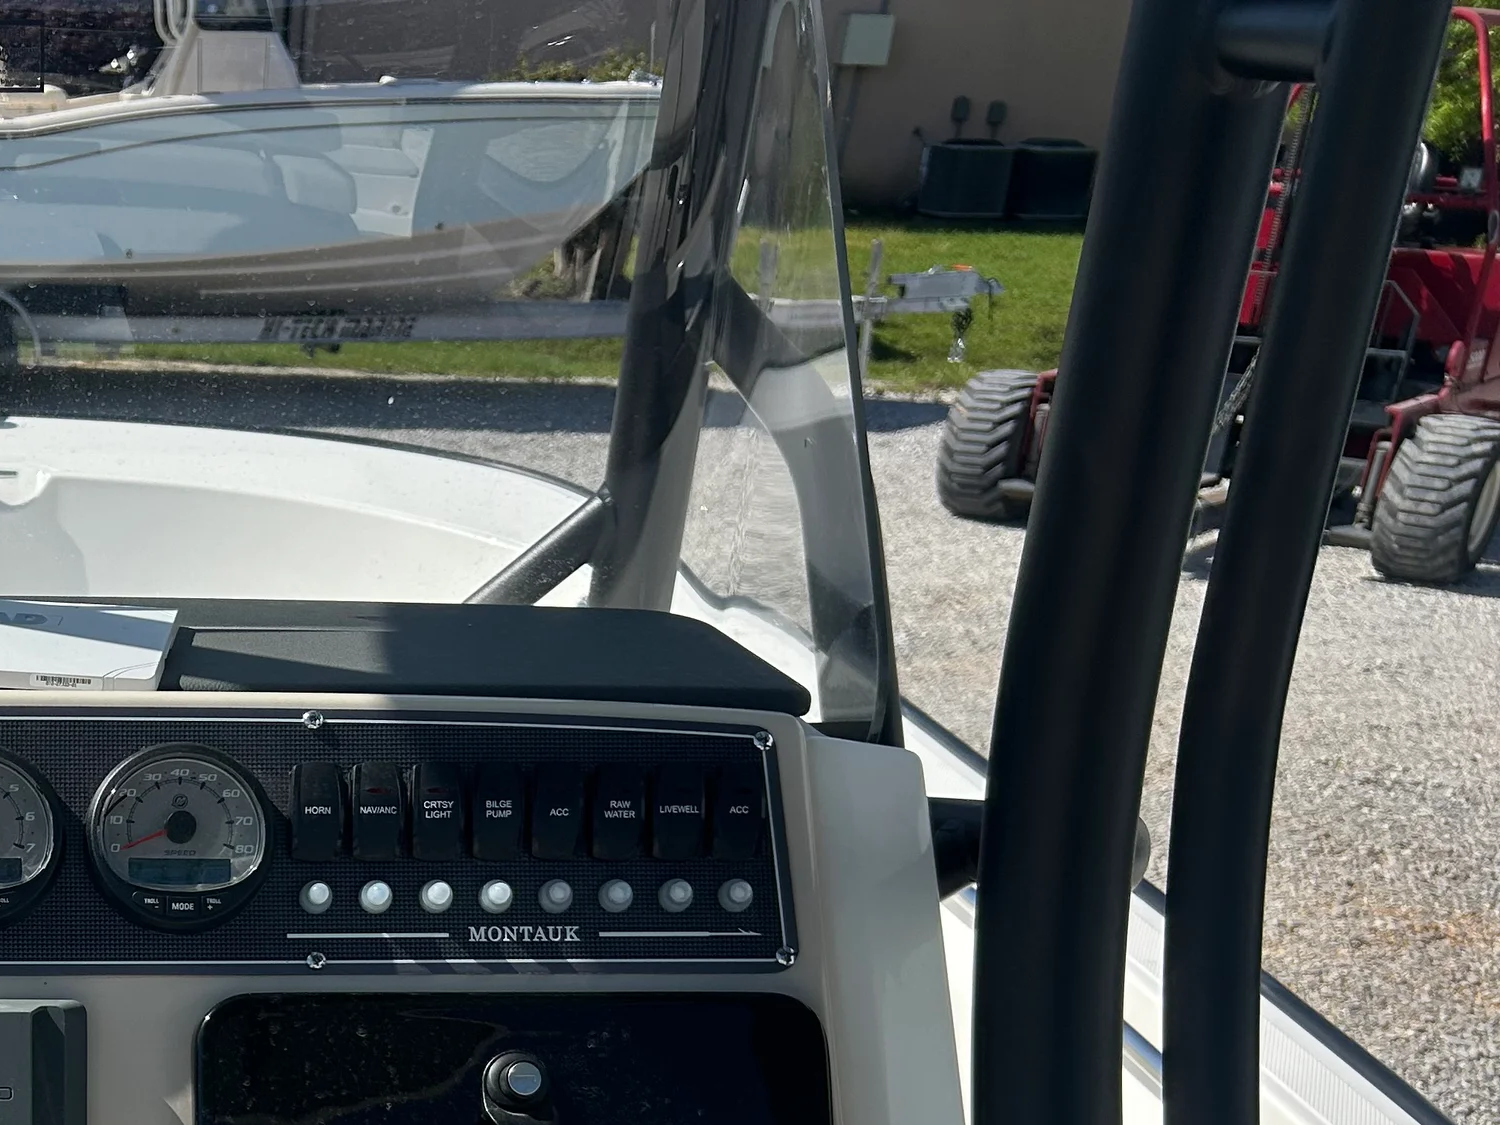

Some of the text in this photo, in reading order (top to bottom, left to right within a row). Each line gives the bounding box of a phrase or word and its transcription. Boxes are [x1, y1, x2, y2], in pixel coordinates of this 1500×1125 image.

[199, 774, 217, 782] 50
[9, 784, 19, 792] 5
[119, 788, 137, 797] 20
[222, 789, 240, 797] 60
[423, 800, 454, 809] CRTSY
[485, 800, 512, 809] BILGE
[610, 800, 631, 809] RAW
[305, 806, 332, 815] HORN
[359, 806, 397, 815] NAV/ANC
[485, 810, 512, 818] PUMP
[549, 808, 569, 817] ACC
[659, 805, 700, 814] LIVEWELL
[729, 805, 749, 814] ACC
[25, 812, 35, 820] 6
[425, 810, 452, 819] LIGHT
[604, 810, 636, 819] WATER
[110, 816, 123, 824] 10
[235, 817, 253, 825] 70
[26, 843, 36, 852] 7
[110, 844, 121, 852] 0
[235, 845, 254, 854] 80
[171, 902, 194, 911] MODE
[468, 925, 581, 942] MONTAUK
